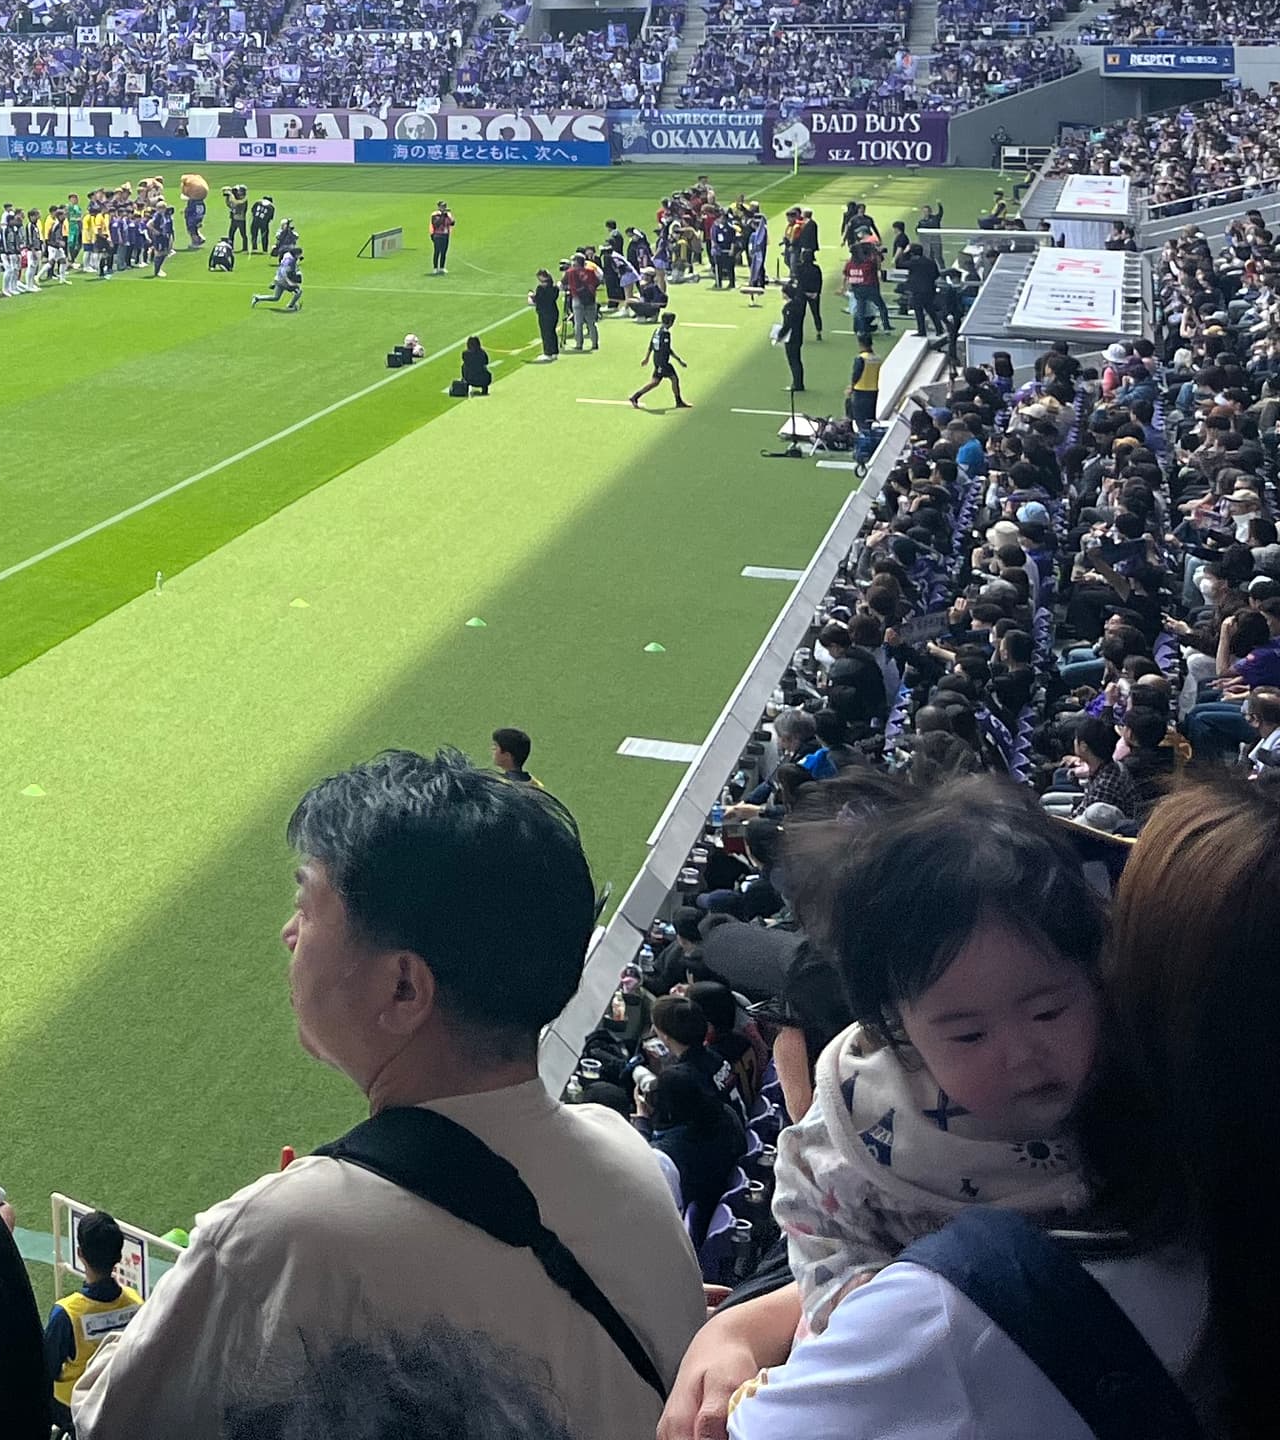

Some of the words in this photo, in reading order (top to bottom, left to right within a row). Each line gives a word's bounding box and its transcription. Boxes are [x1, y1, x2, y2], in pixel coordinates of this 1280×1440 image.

[1130, 54, 1176, 67] RESPECT
[730, 112, 764, 124] CLUB
[812, 112, 857, 134] BAD
[10, 139, 173, 157] 海の惑星とともに、次へ。
[651, 128, 763, 150] OKAYAMA
[239, 143, 277, 156] MOL
[392, 143, 579, 162] 海の惑星とともに、次へ。
[857, 140, 932, 162] TOKYO
